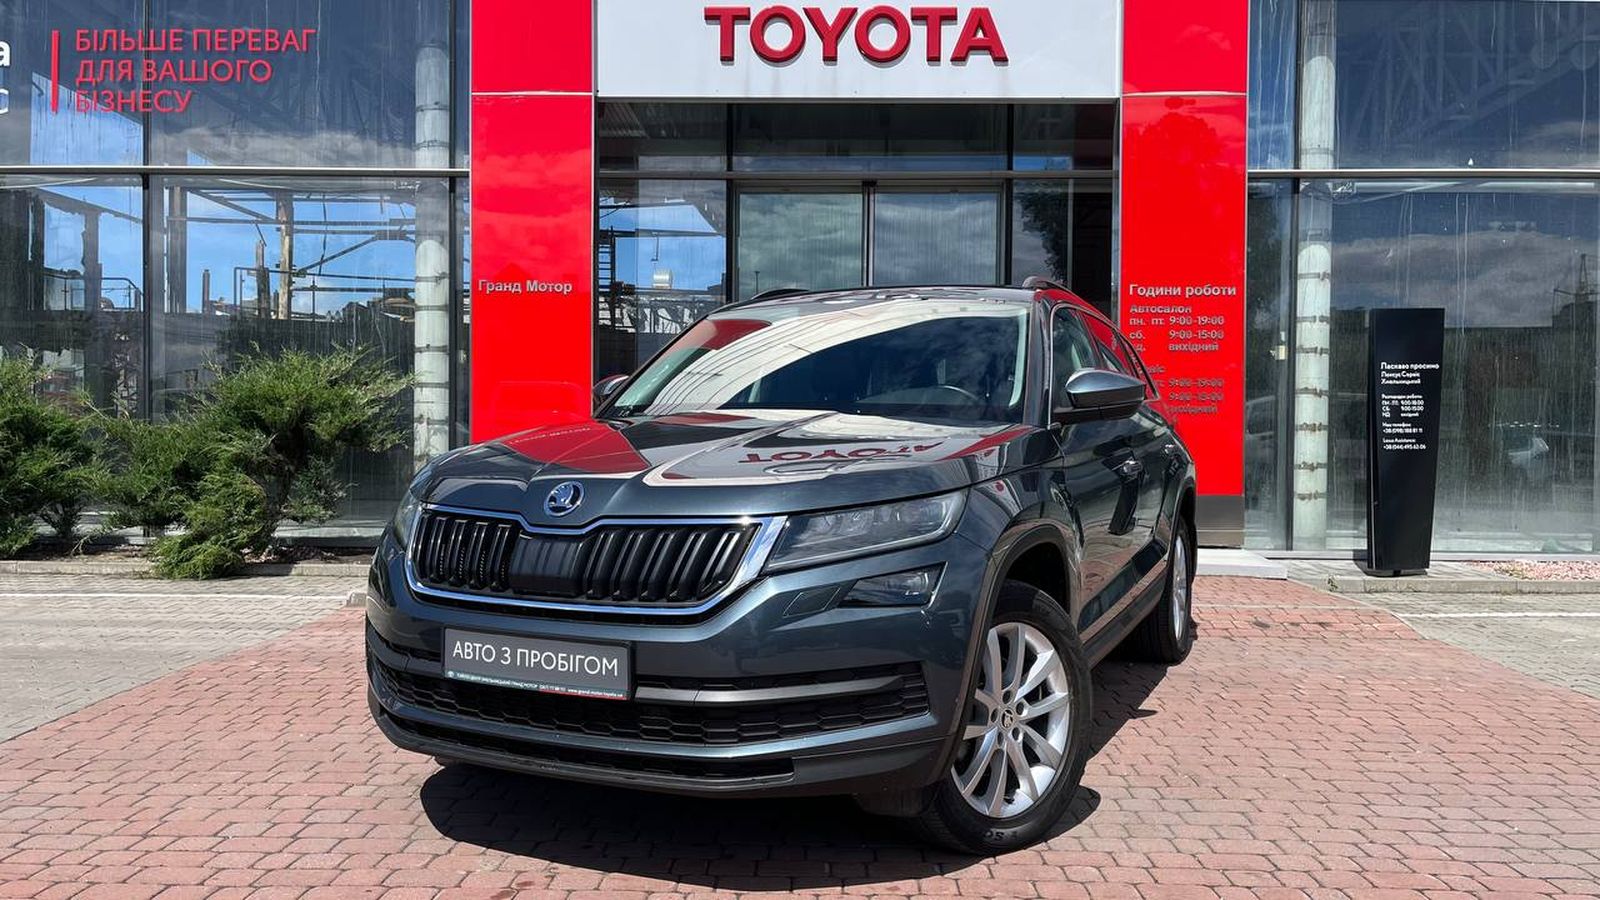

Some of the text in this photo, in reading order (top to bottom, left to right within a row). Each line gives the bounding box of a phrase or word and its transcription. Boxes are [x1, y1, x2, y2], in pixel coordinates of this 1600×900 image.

[76, 29, 316, 51] БІЛЬШЕ ПЕРЕВАГ
[704, 5, 1009, 63] TOYOTA
[75, 59, 272, 86] ДЛЯ ВАШОГО
[76, 89, 192, 113] БІЗНЕСУ
[478, 279, 573, 295] Гранд Мотор
[1129, 283, 1236, 298] Години роботи
[1129, 305, 1192, 314] Автосалон
[453, 641, 496, 662] АВТО
[516, 649, 618, 676] ПРОБІГОМ
